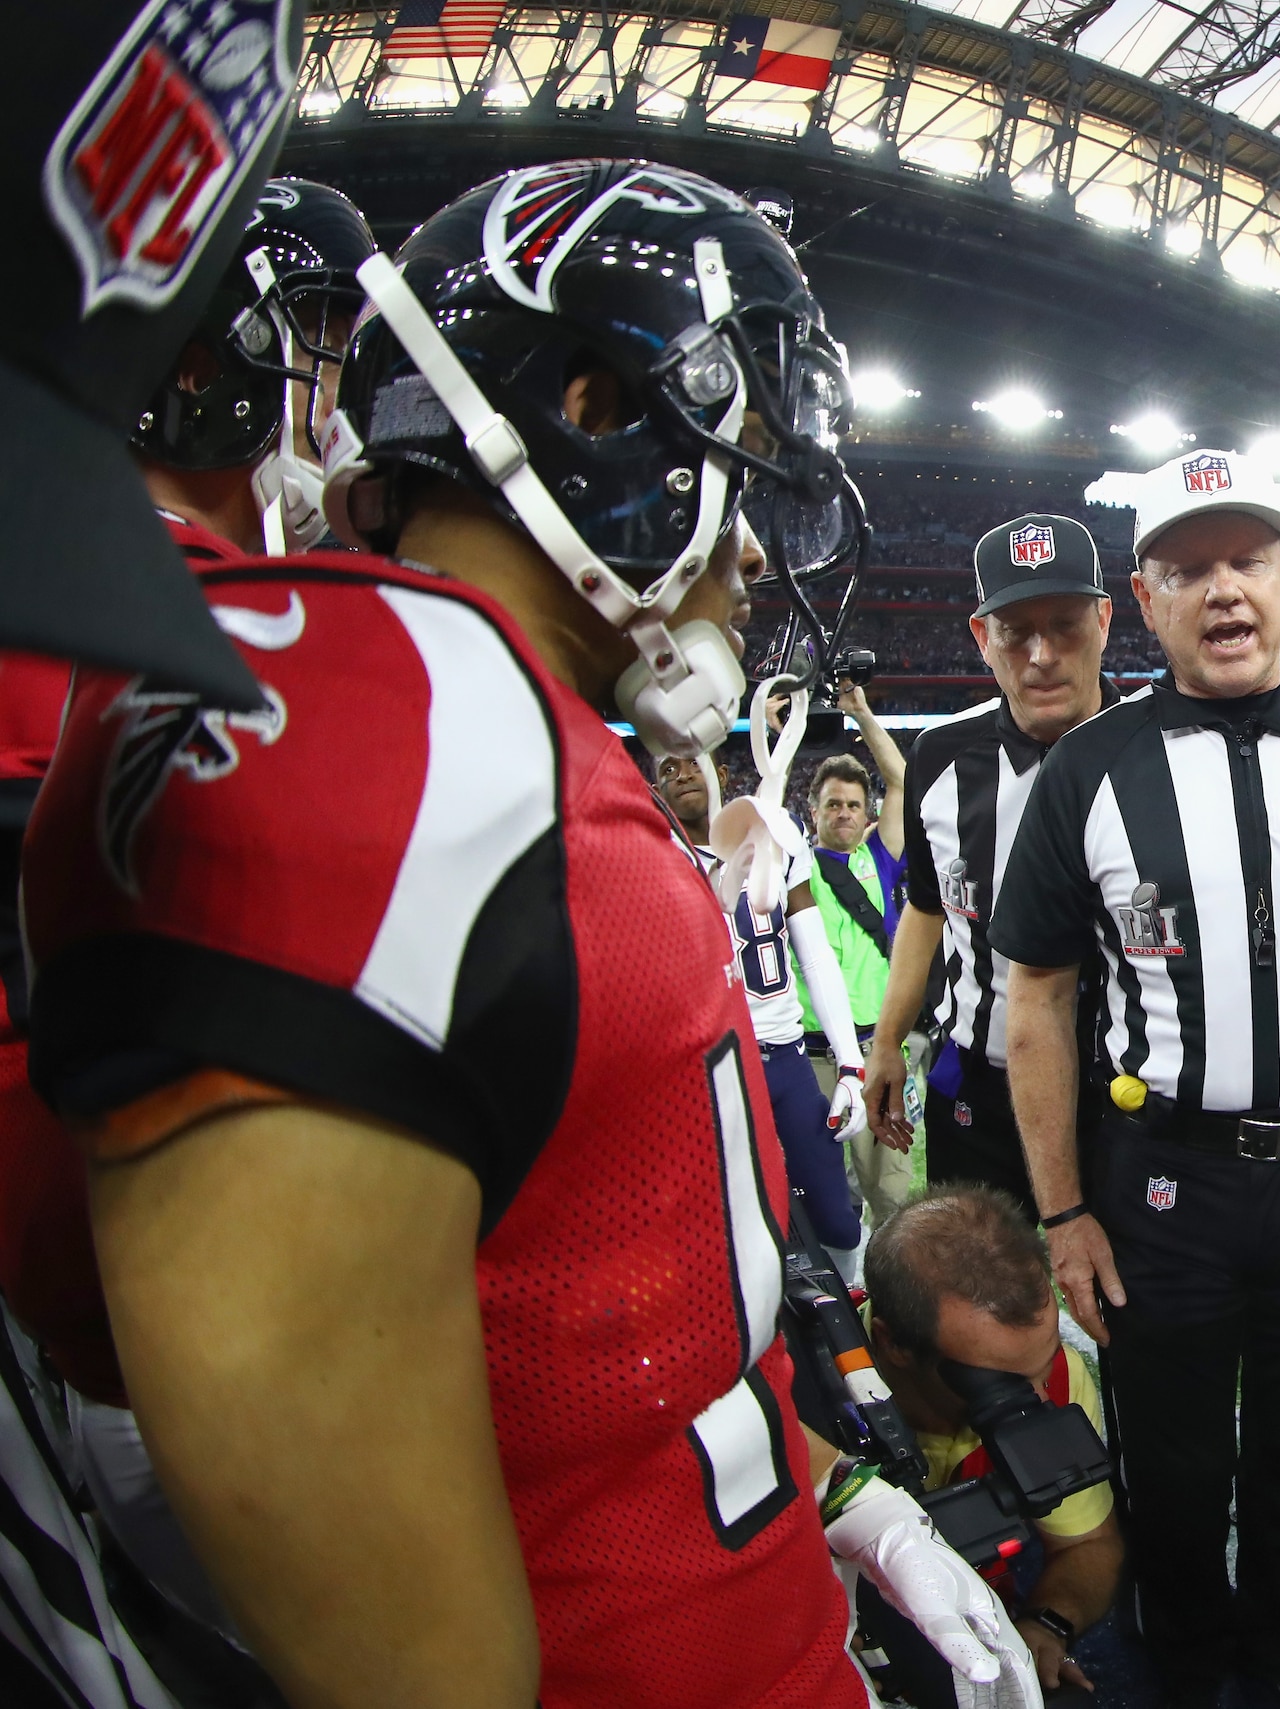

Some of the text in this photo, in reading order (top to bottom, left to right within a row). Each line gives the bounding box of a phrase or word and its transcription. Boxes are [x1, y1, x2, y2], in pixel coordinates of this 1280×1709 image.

[1186, 469, 1229, 492] NFL
[1015, 540, 1050, 562] NFL
[1150, 1190, 1171, 1206] NFL
